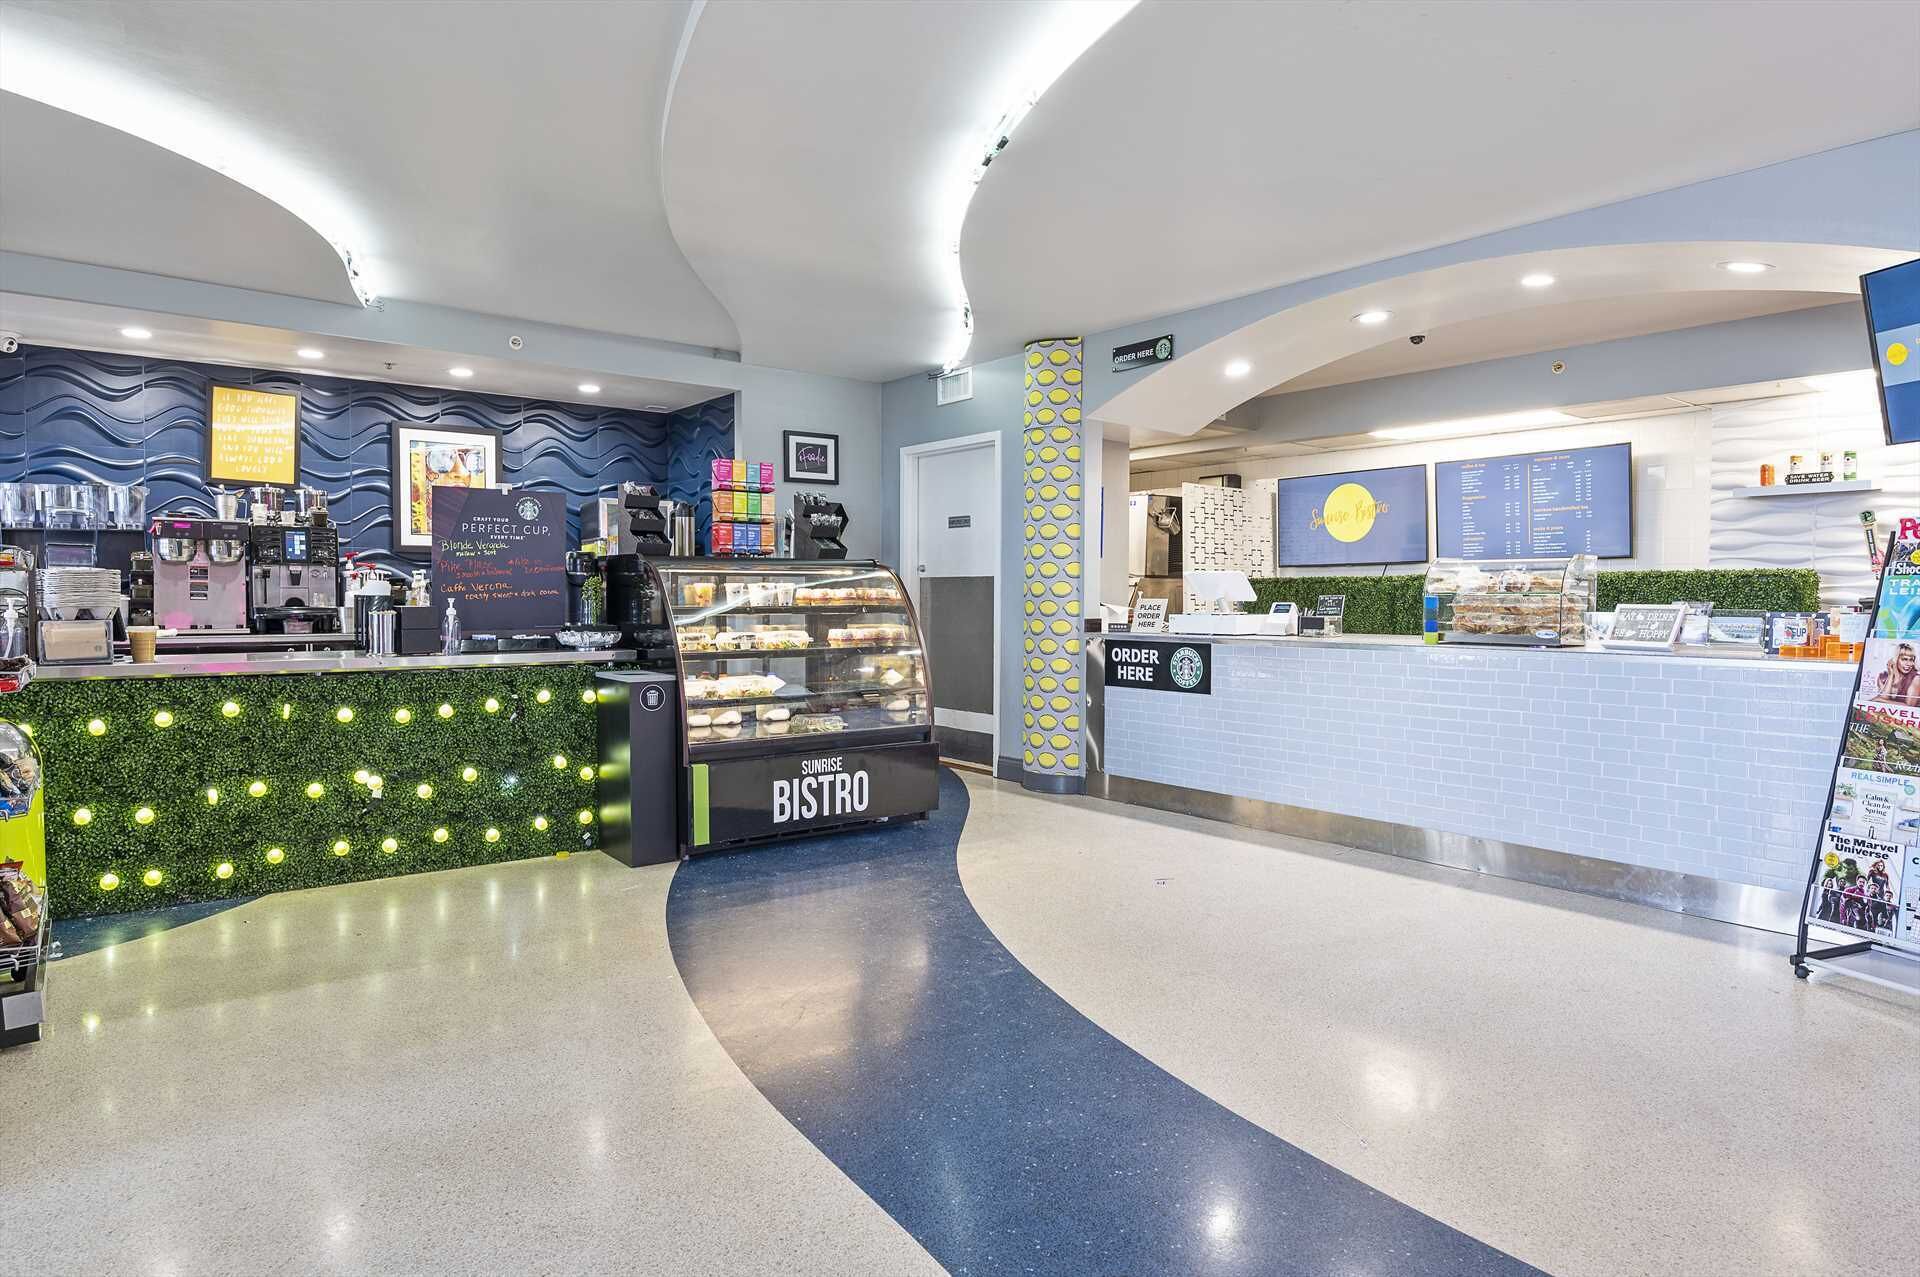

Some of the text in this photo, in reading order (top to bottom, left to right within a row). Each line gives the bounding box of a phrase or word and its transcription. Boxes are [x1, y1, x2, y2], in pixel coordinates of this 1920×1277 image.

[1114, 348, 1154, 364] ORDER HERE
[462, 522, 518, 534] PERFECT
[1111, 647, 1160, 665] ORDER
[1117, 664, 1154, 682] HERE
[1175, 674, 1198, 687] COFFEE
[1856, 703, 1919, 719] TRAVEL
[801, 756, 843, 775] SUNRISE
[1851, 771, 1911, 787] REAL SIMPLE
[773, 770, 869, 825] BISTRO
[1862, 799, 1882, 809] Clean
[1865, 806, 1887, 817] Spring
[1829, 833, 1899, 854] The Marvel
[1835, 843, 1890, 860] Universe
